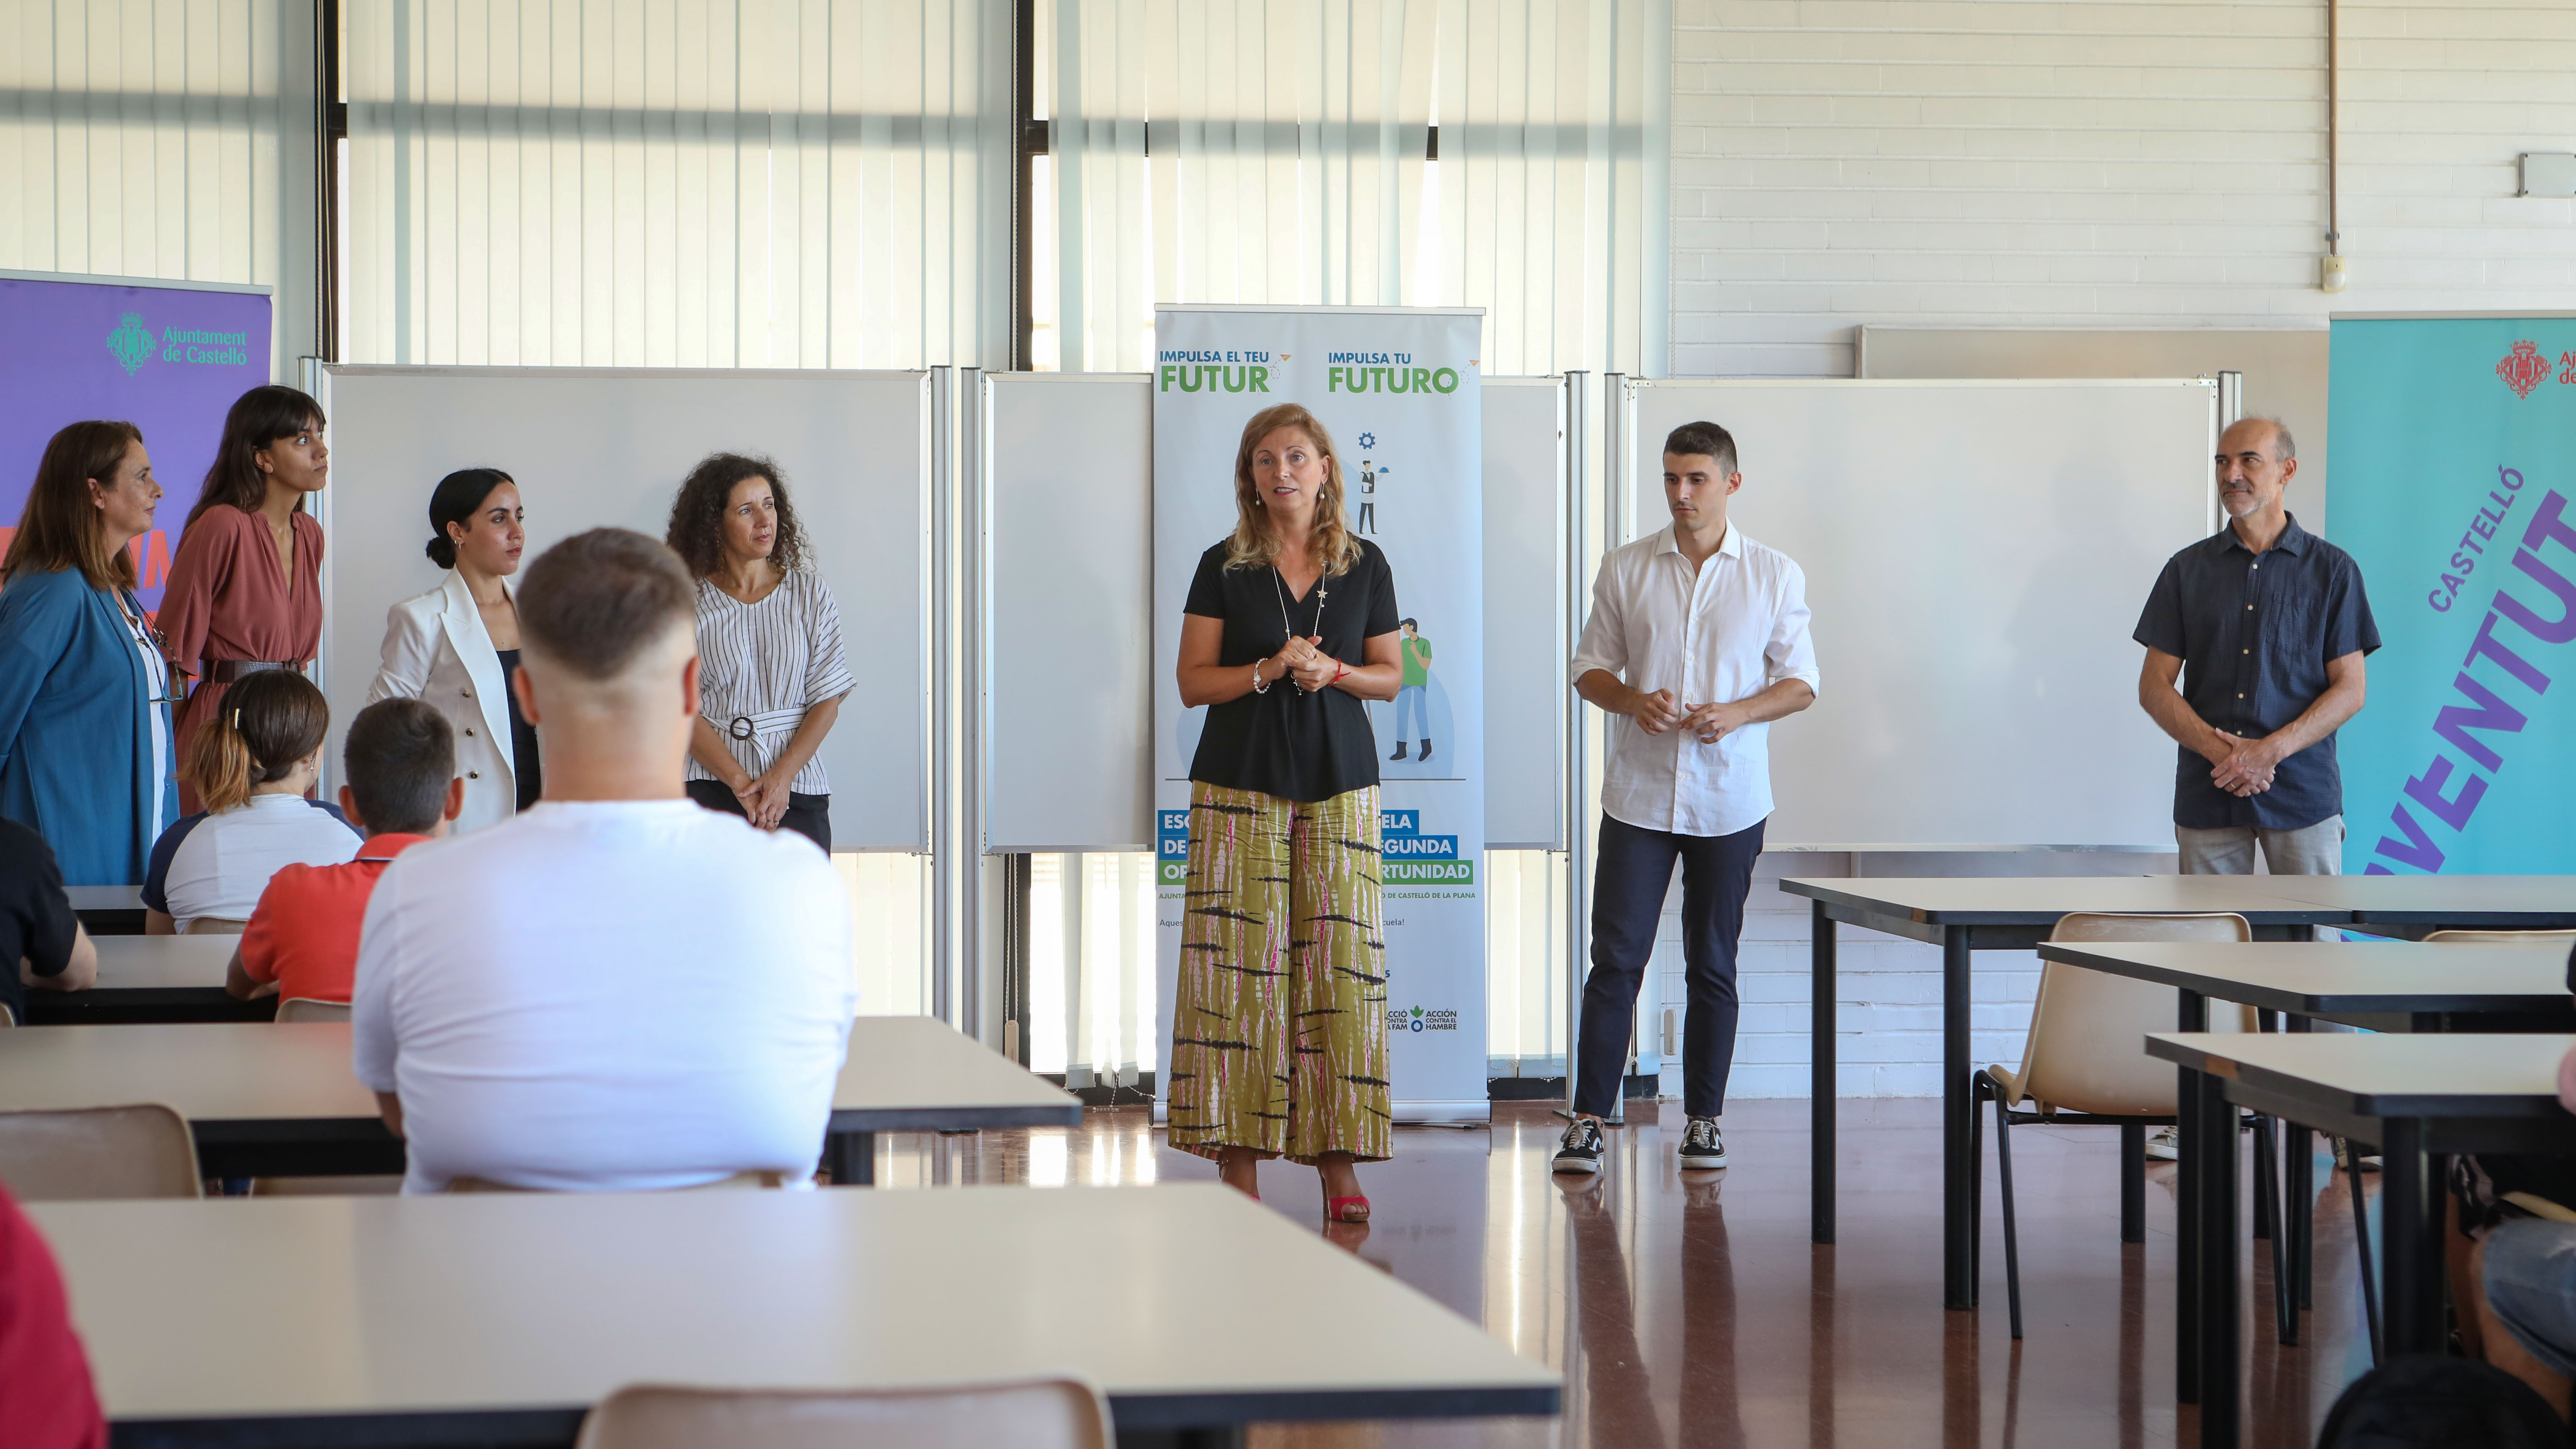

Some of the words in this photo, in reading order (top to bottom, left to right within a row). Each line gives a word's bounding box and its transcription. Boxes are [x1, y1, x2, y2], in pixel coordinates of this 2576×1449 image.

[163, 326, 247, 347] Ajuntament
[163, 344, 181, 362] de
[187, 346, 247, 365] Castelló
[1160, 351, 1222, 362] IMPULSA
[1227, 351, 1240, 362] EL
[1244, 352, 1269, 363] TEU
[1329, 352, 1390, 364] IMPULSA
[1394, 353, 1411, 364] TU
[1161, 365, 1270, 393] FUTUR
[1329, 367, 1459, 394] FUTURO
[2428, 463, 2524, 613] CASTELLÓ
[1164, 840, 1186, 854] DE
[1426, 1008, 1457, 1017] ACCIÓN
